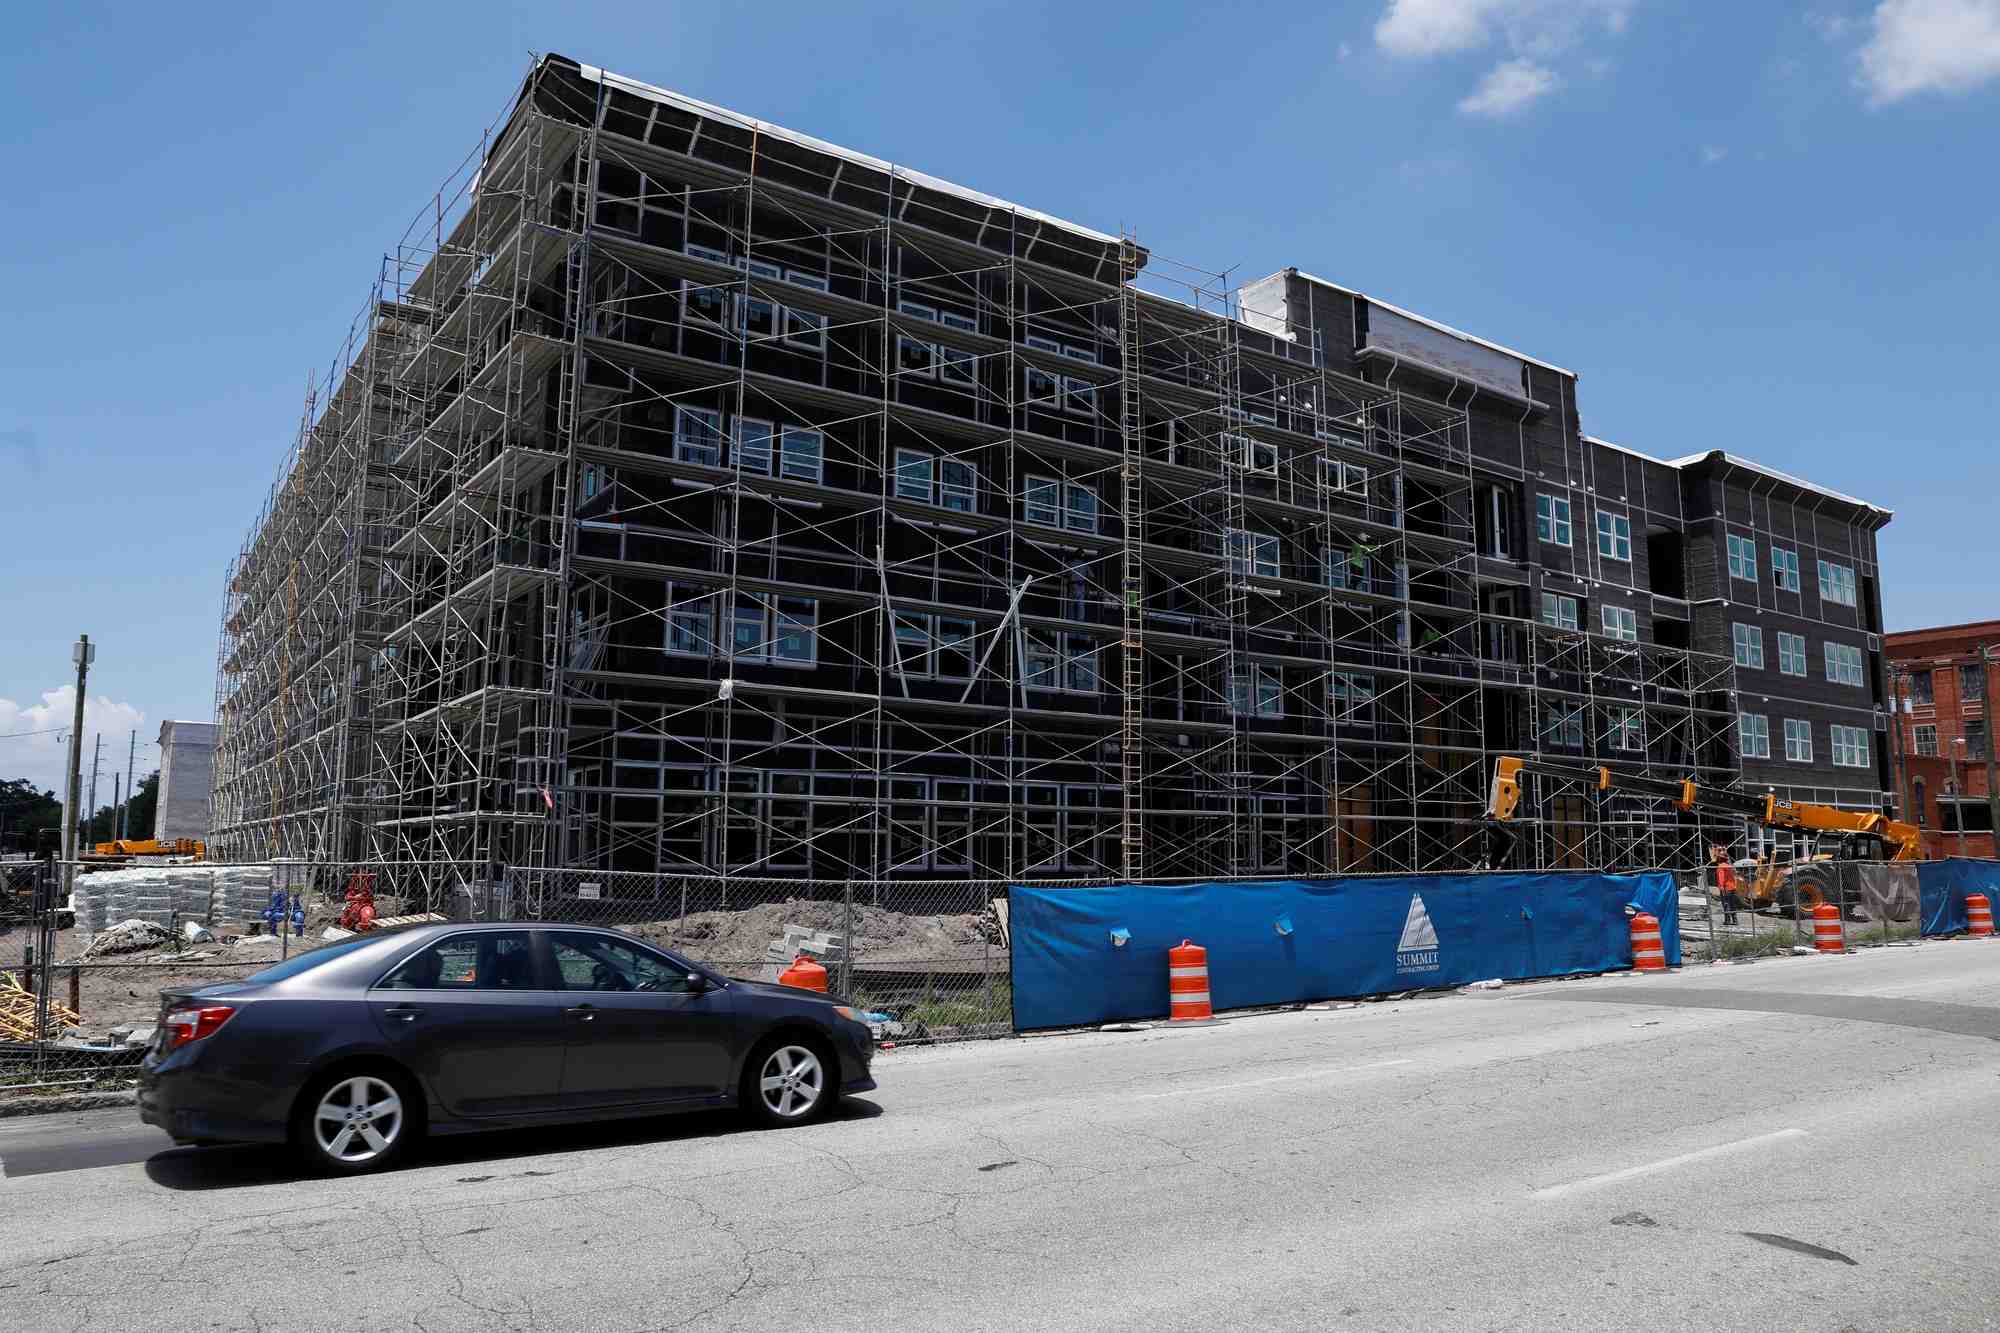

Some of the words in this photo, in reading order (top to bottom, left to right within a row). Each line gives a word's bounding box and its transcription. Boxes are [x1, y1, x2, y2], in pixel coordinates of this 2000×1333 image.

[1775, 799, 1792, 809] JCB
[157, 840, 176, 848] JCB
[1396, 952, 1439, 967] SUMMIT
